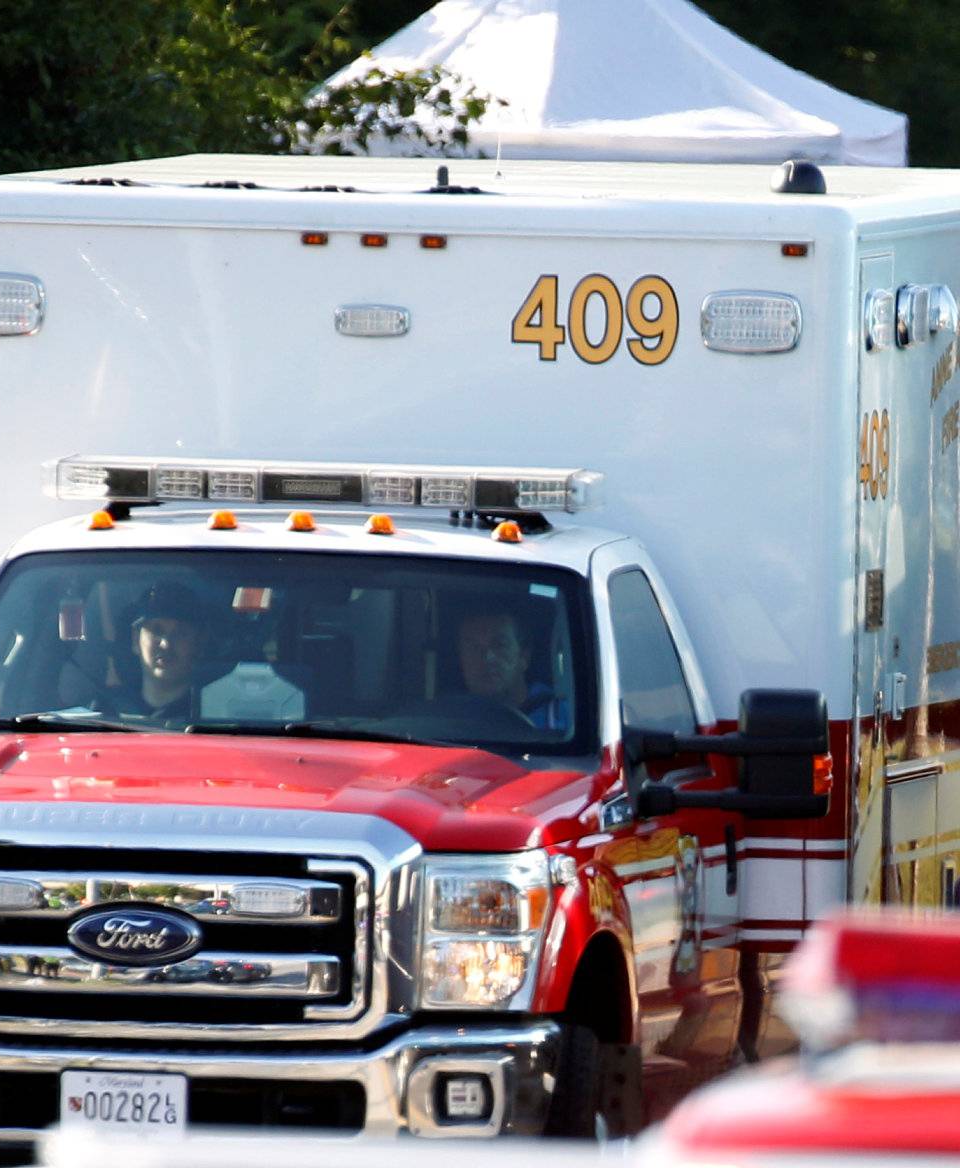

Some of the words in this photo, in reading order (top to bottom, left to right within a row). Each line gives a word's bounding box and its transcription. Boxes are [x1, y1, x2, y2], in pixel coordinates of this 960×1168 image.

[511, 273, 680, 366] 409
[859, 408, 890, 501] 409
[96, 917, 168, 949] Ford
